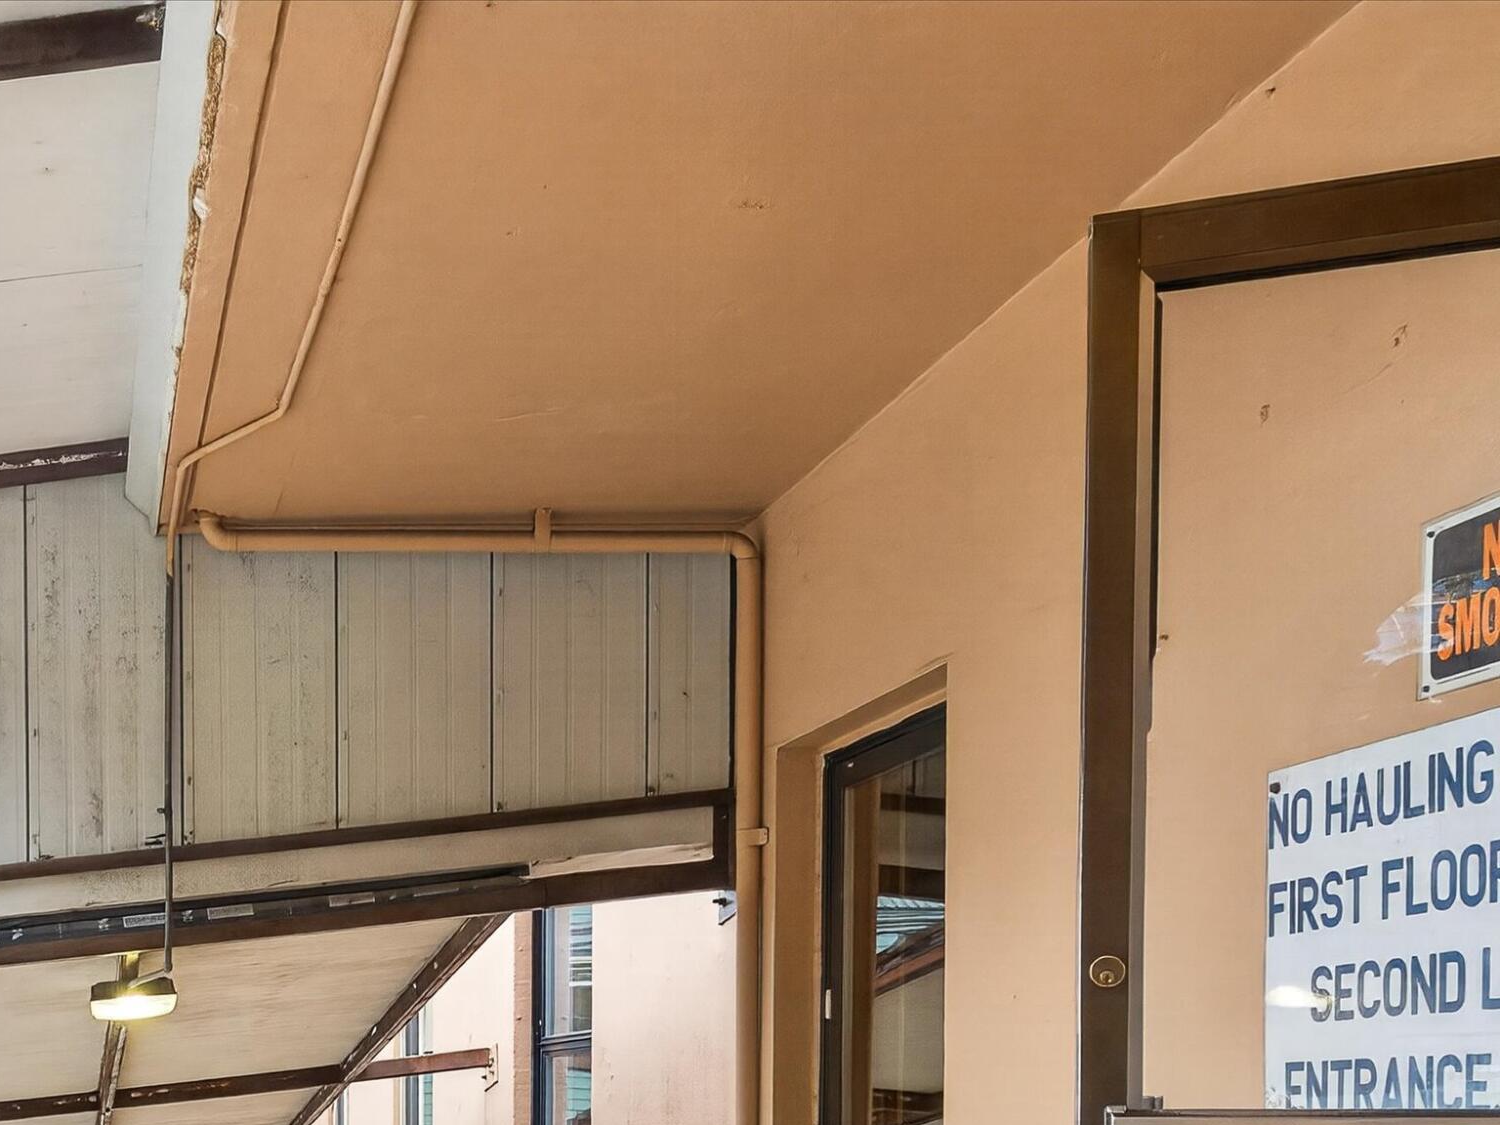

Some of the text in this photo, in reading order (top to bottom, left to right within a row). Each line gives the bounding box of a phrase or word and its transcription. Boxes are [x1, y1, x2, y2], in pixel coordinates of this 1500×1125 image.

[1269, 740, 1494, 849] NO HAULING
[1269, 865, 1368, 937] FIRST
[1311, 951, 1466, 1022] SECOND
